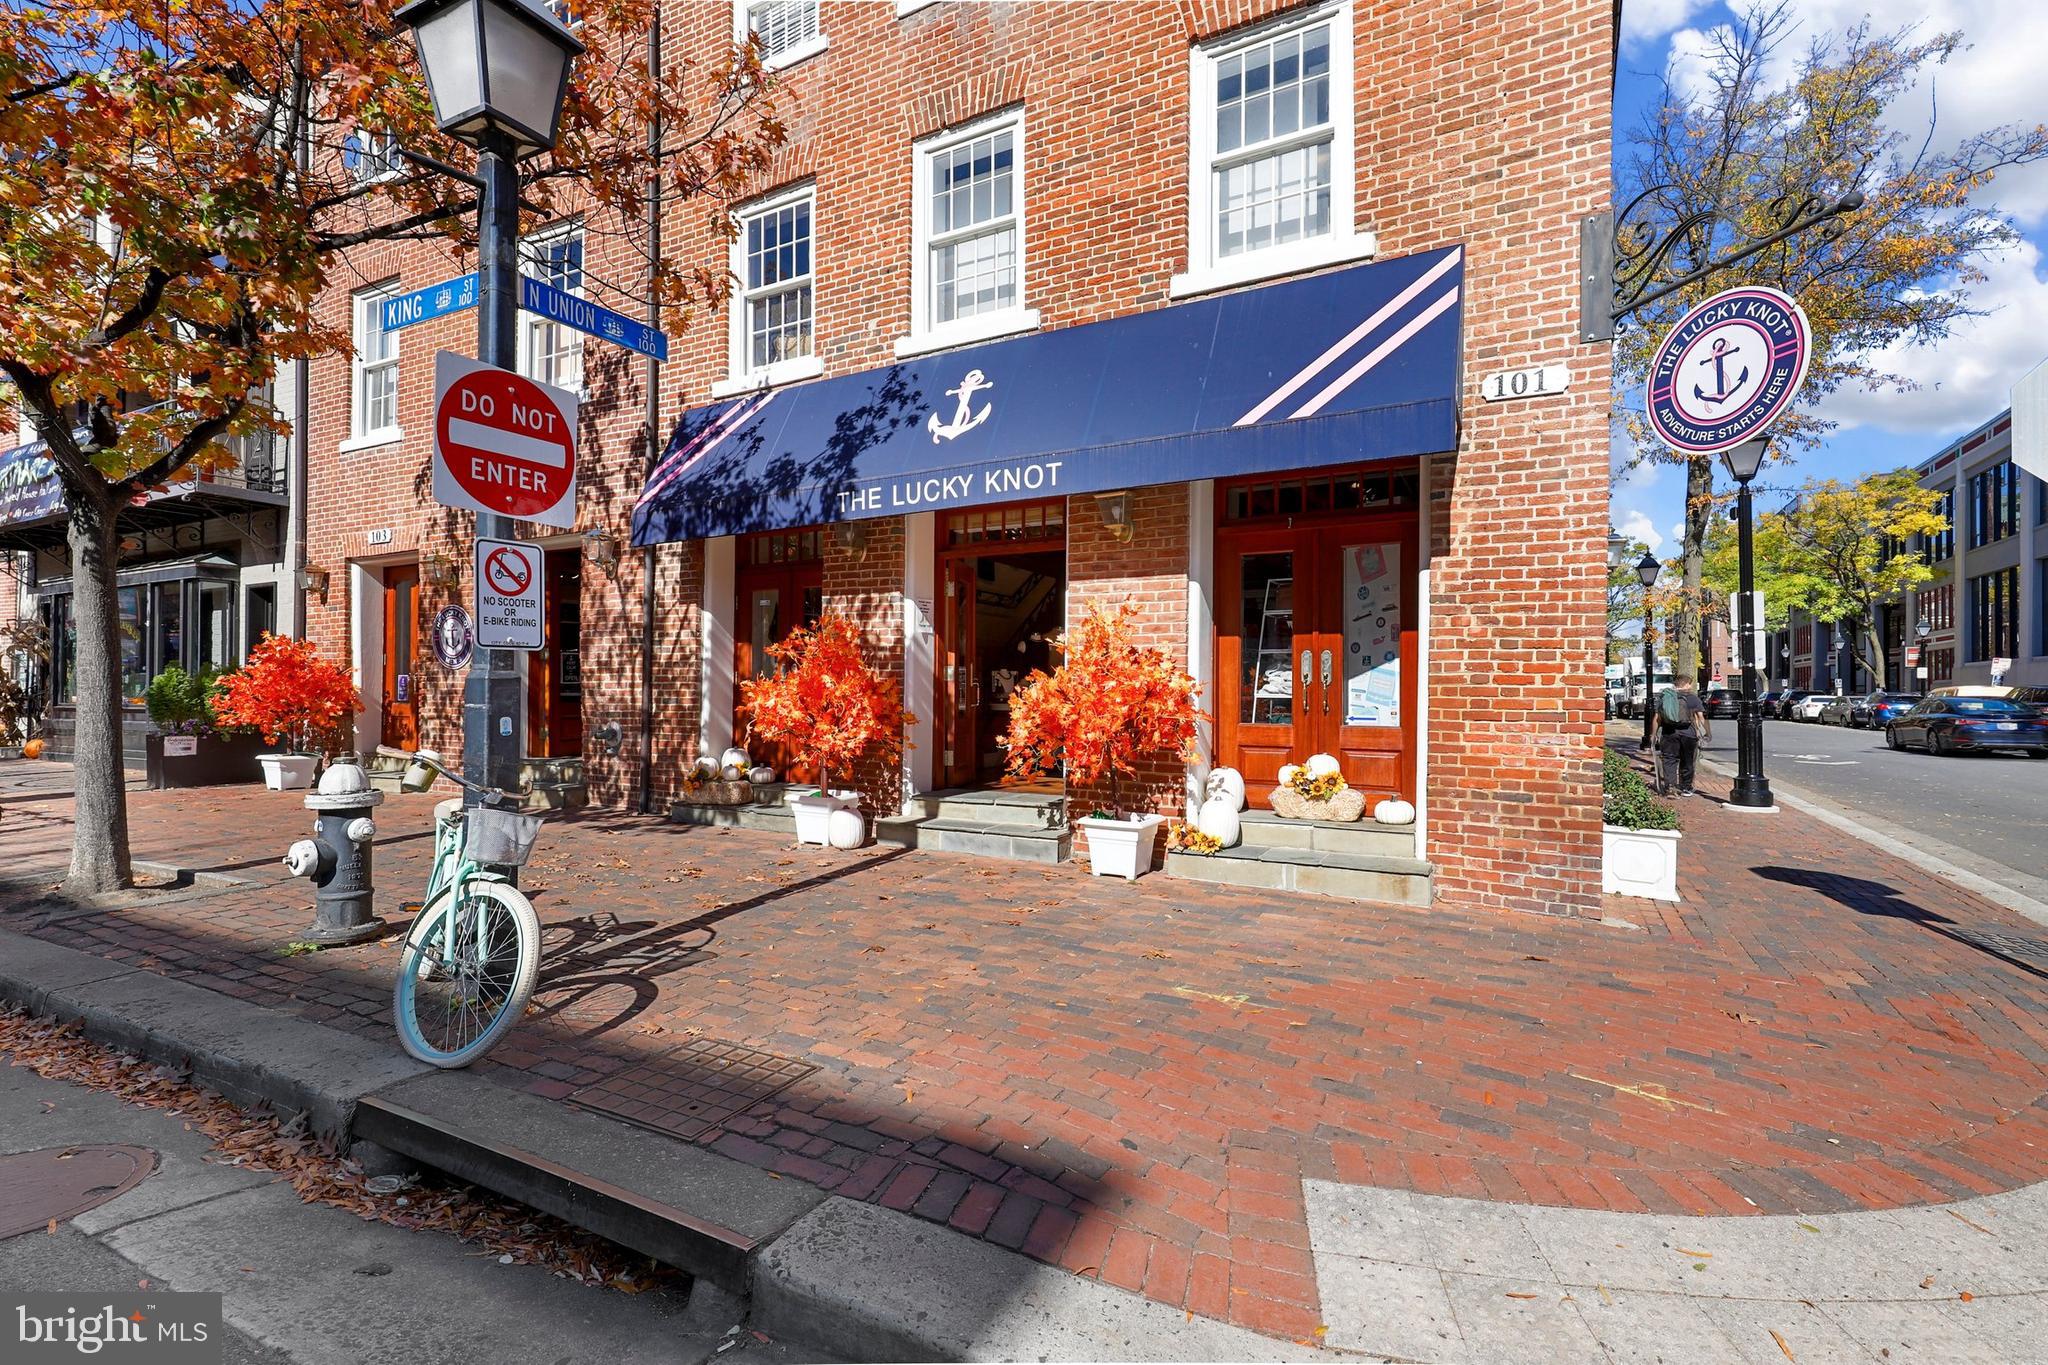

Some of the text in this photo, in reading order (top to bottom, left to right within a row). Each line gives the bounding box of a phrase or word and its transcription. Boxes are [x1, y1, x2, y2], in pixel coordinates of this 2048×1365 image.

[388, 279, 474, 326] KING ST
[458, 292, 472, 306] 100
[529, 283, 655, 341] N UNION ST
[638, 340, 656, 354] 100
[1658, 301, 1789, 378] THE LUCKY KNOT
[1494, 368, 1547, 397] 101
[461, 388, 557, 433] DO NOT
[1659, 367, 1789, 441] ADVENTURE STARTS HERE
[471, 458, 547, 493] ENTER
[837, 462, 1063, 513] THE LUCKY KNOT
[371, 529, 387, 543] 103
[483, 596, 536, 608] NO SCOOTER
[503, 608, 517, 617] OR
[483, 616, 537, 627] E-BIKE RIDING
